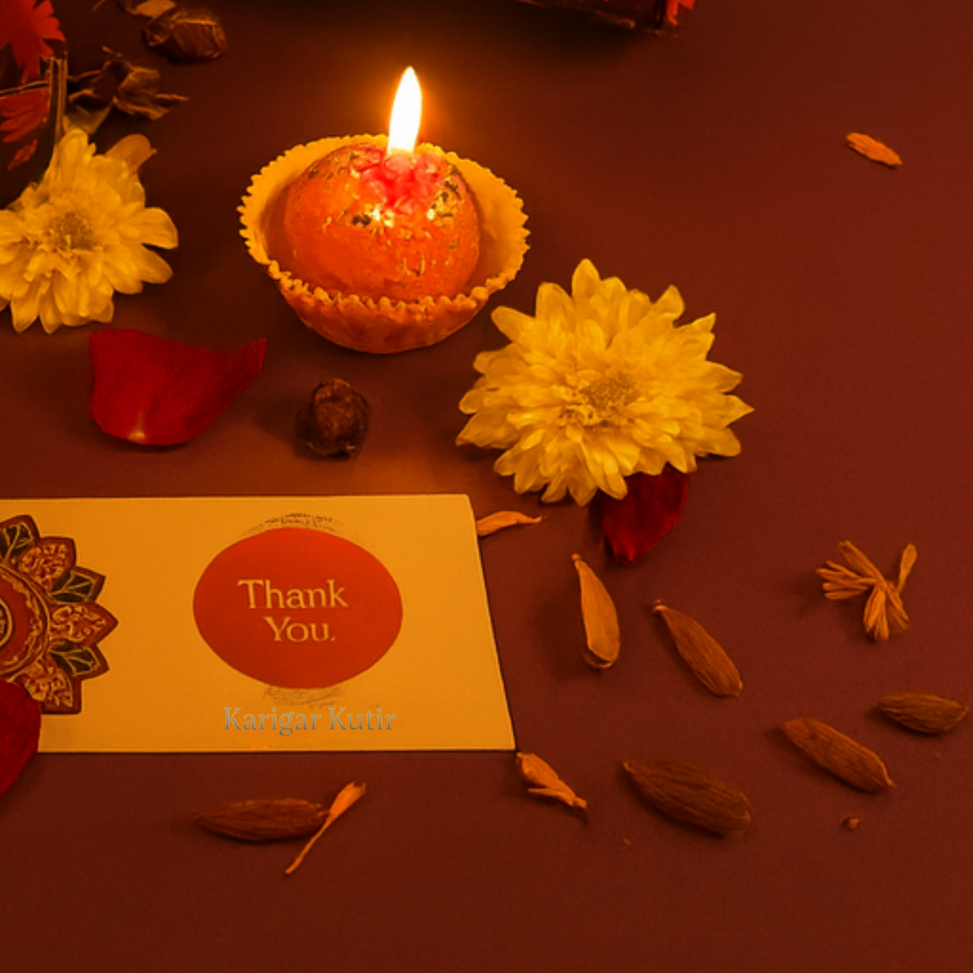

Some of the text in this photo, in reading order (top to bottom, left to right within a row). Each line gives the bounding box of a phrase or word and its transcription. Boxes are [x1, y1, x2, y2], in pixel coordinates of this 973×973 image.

[237, 579, 349, 609] Thank
[223, 707, 397, 737] Karigar Kutir
